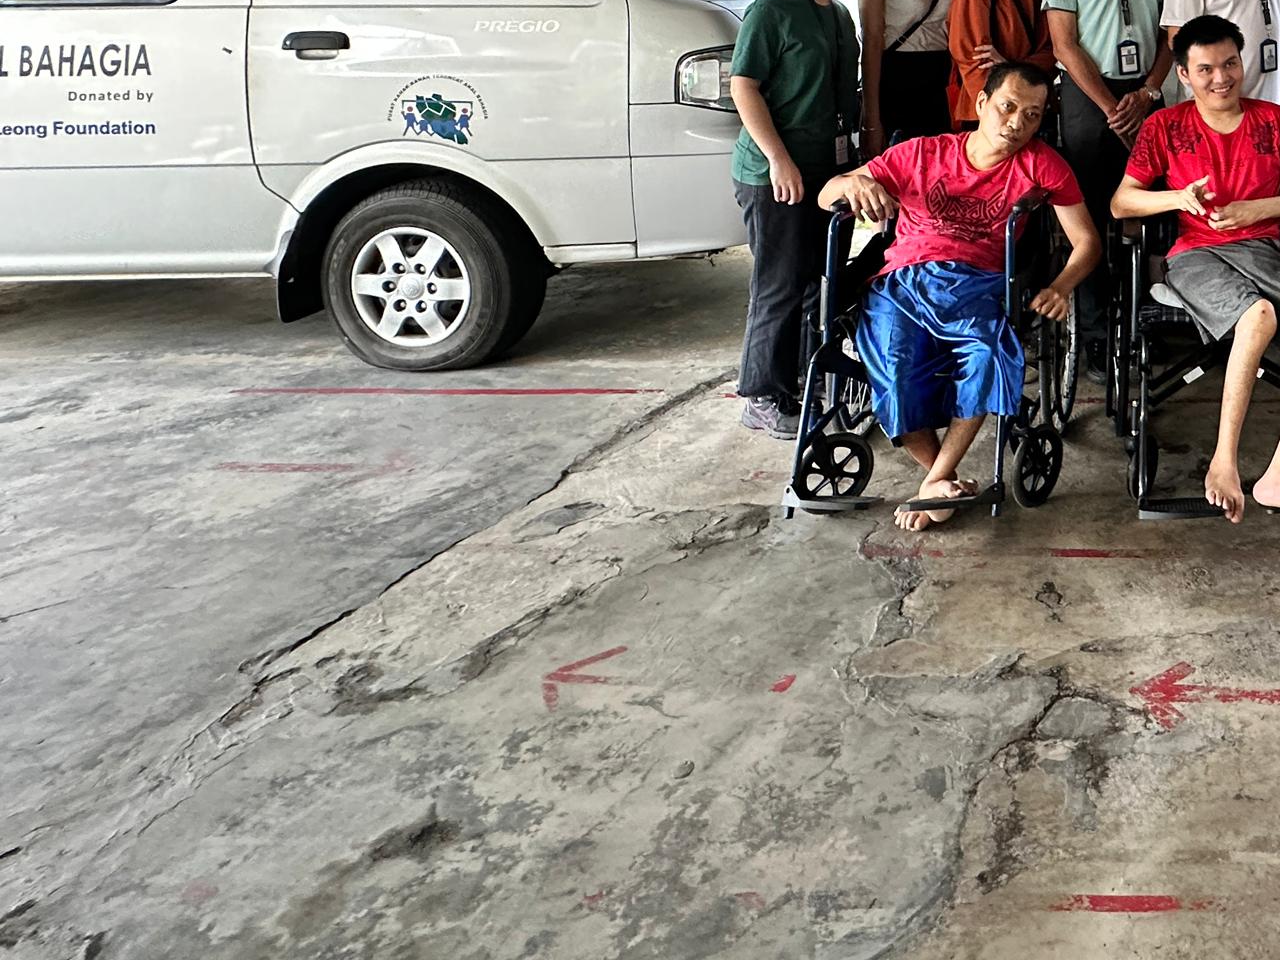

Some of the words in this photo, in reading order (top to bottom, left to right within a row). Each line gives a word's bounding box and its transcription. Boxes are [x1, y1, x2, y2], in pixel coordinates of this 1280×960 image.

[473, 19, 561, 33] PREGIO
[19, 43, 152, 77] BAHAGIA
[68, 90, 131, 102] Donated
[136, 89, 154, 103] by
[0, 124, 48, 139] eong
[52, 120, 156, 136] Foundation
